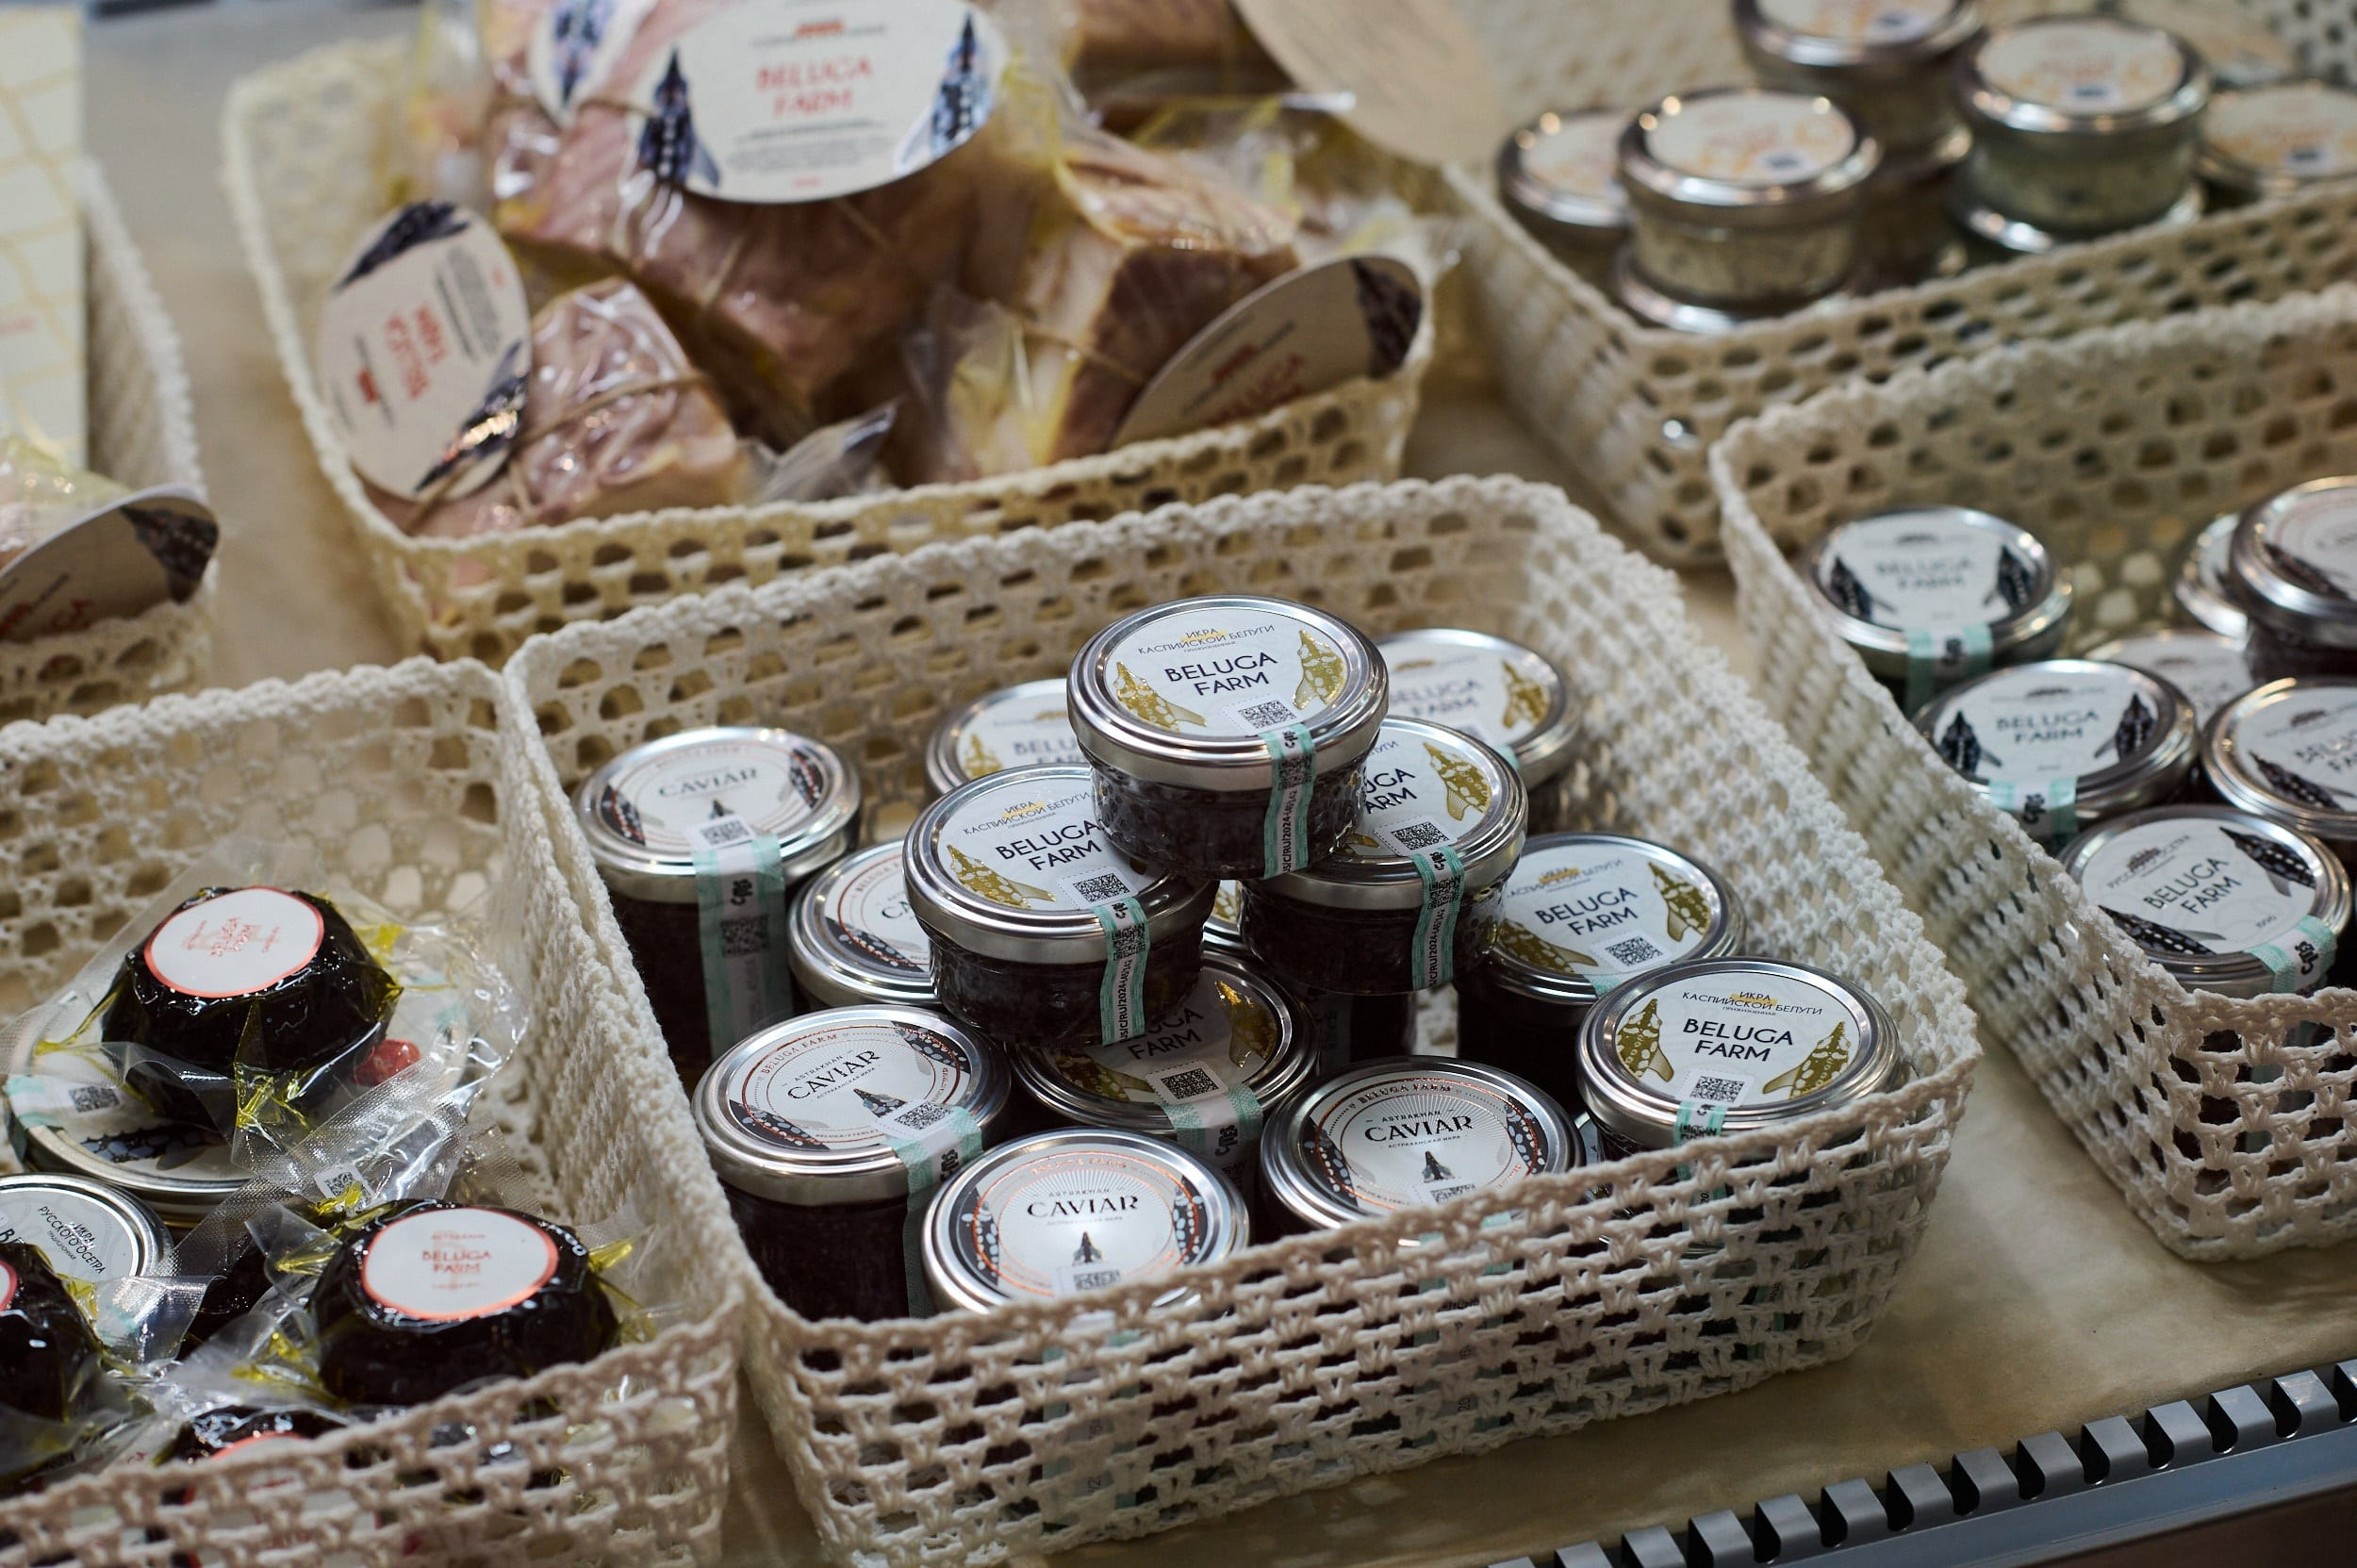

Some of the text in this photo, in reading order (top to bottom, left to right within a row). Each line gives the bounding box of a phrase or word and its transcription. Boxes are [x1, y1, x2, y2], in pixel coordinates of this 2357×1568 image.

[756, 55, 874, 92] BELUGA
[772, 89, 853, 119] FARM
[1138, 635, 1227, 655] КАСПИЙСКОЙ
[1186, 627, 1218, 638] ИКРА
[1164, 652, 1278, 683] BELUGA
[1194, 671, 1270, 696] FARM
[1996, 709, 2101, 731] BELUGA
[1014, 737, 1077, 756] BELU
[2015, 727, 2084, 743] FARM
[659, 768, 758, 798] CAVIAR
[1363, 768, 1416, 794] UGA
[1005, 801, 1036, 813] ИКРА
[1364, 787, 1418, 815] ARM
[963, 806, 1045, 835] КАСПИЙСКОЙ
[996, 819, 1102, 860] BELUGA
[1028, 839, 1102, 871] FARM
[2143, 857, 2229, 910] BELUGA
[2180, 876, 2242, 915] FARM
[1535, 887, 1639, 924] BELUGA
[1568, 906, 1639, 935] FARM
[1682, 992, 1772, 1010] КАСПИЙСКОЙ
[1739, 991, 1772, 1001] ИКРА
[1128, 1029, 1202, 1060] FARM
[1683, 1018, 1793, 1046] BELUGA
[1694, 1040, 1771, 1062] FARM
[787, 1050, 882, 1099] CAVIAR
[1359, 1085, 1409, 1104] BELUGA
[1364, 1115, 1474, 1142] CAVIAR
[1382, 1111, 1441, 1123] ASTRAKHAN
[1027, 1195, 1138, 1217] CAVIAR
[38, 1206, 79, 1246] РУССКОГО
[76, 1245, 107, 1274] ОСЕТРА
[421, 1250, 492, 1262] BELUGA
